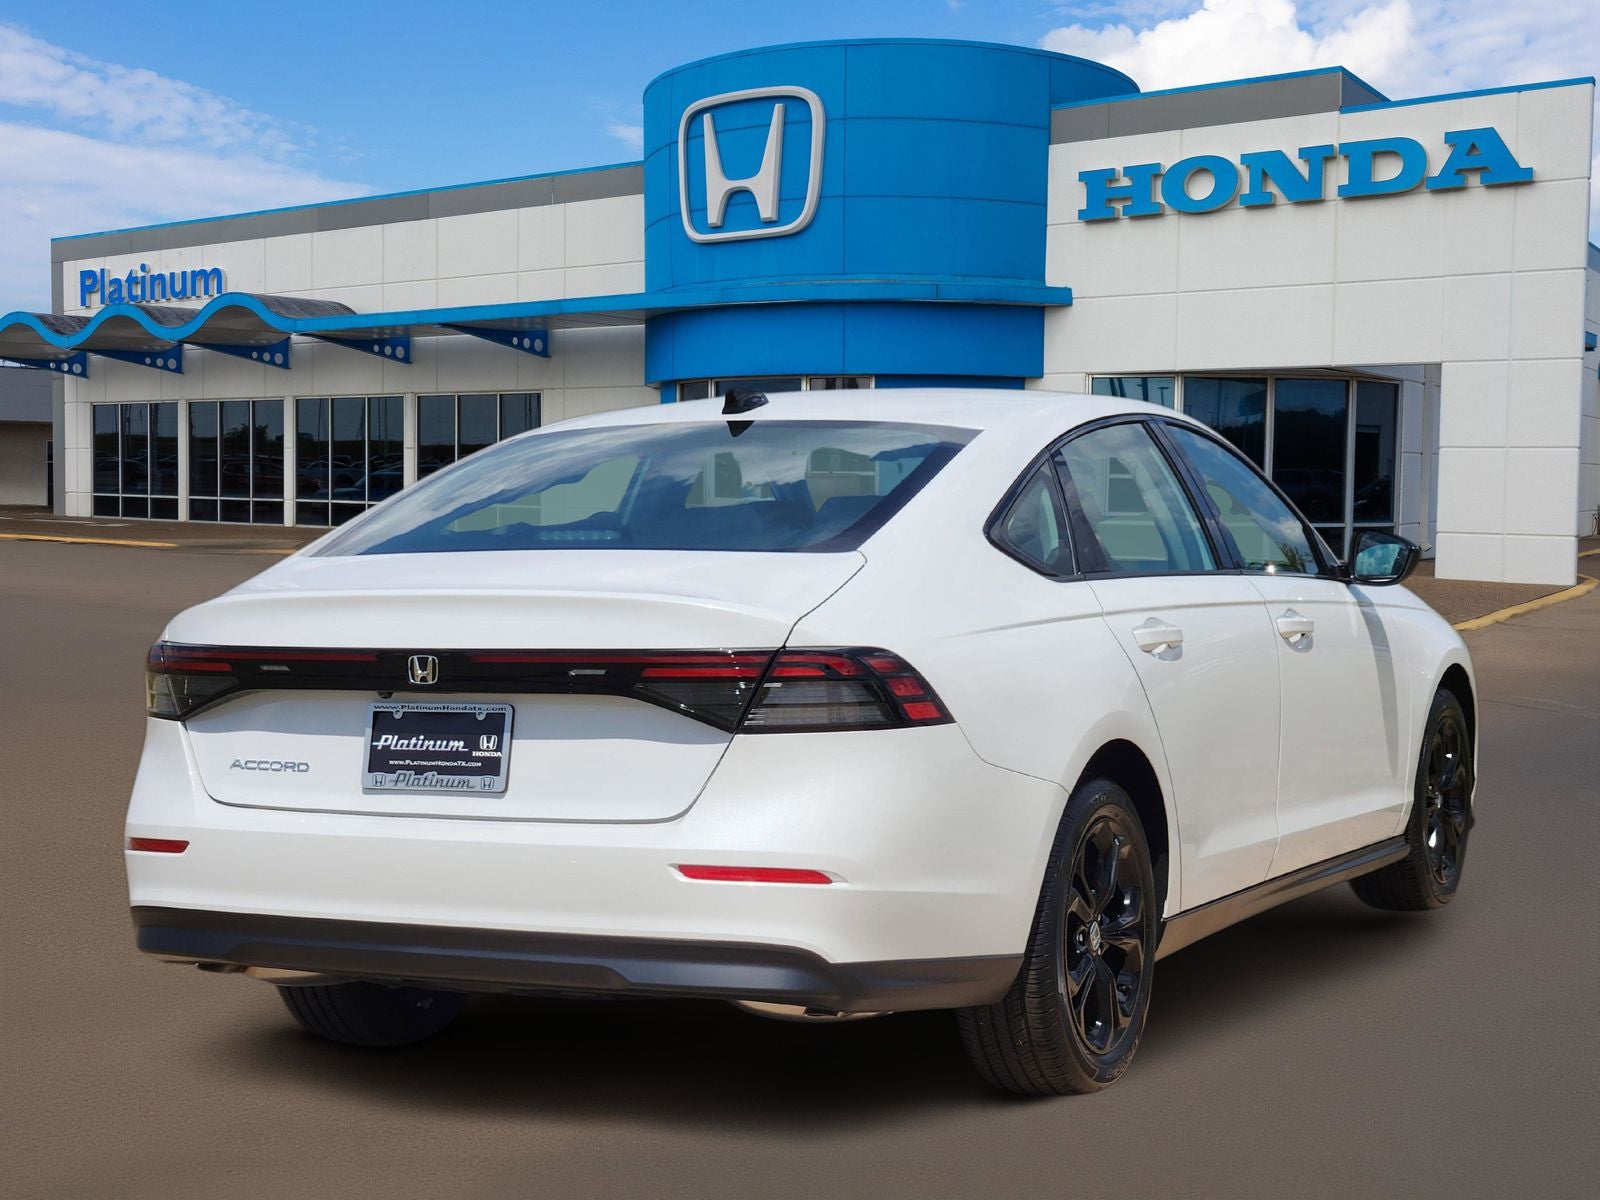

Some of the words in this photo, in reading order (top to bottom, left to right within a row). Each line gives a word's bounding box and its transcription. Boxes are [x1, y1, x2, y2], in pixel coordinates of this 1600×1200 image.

[1077, 126, 1534, 222] HONDA
[79, 262, 225, 307] Platinum
[372, 734, 469, 752] Platinum
[229, 758, 310, 772] ACCORD
[387, 771, 476, 789] Platinum
